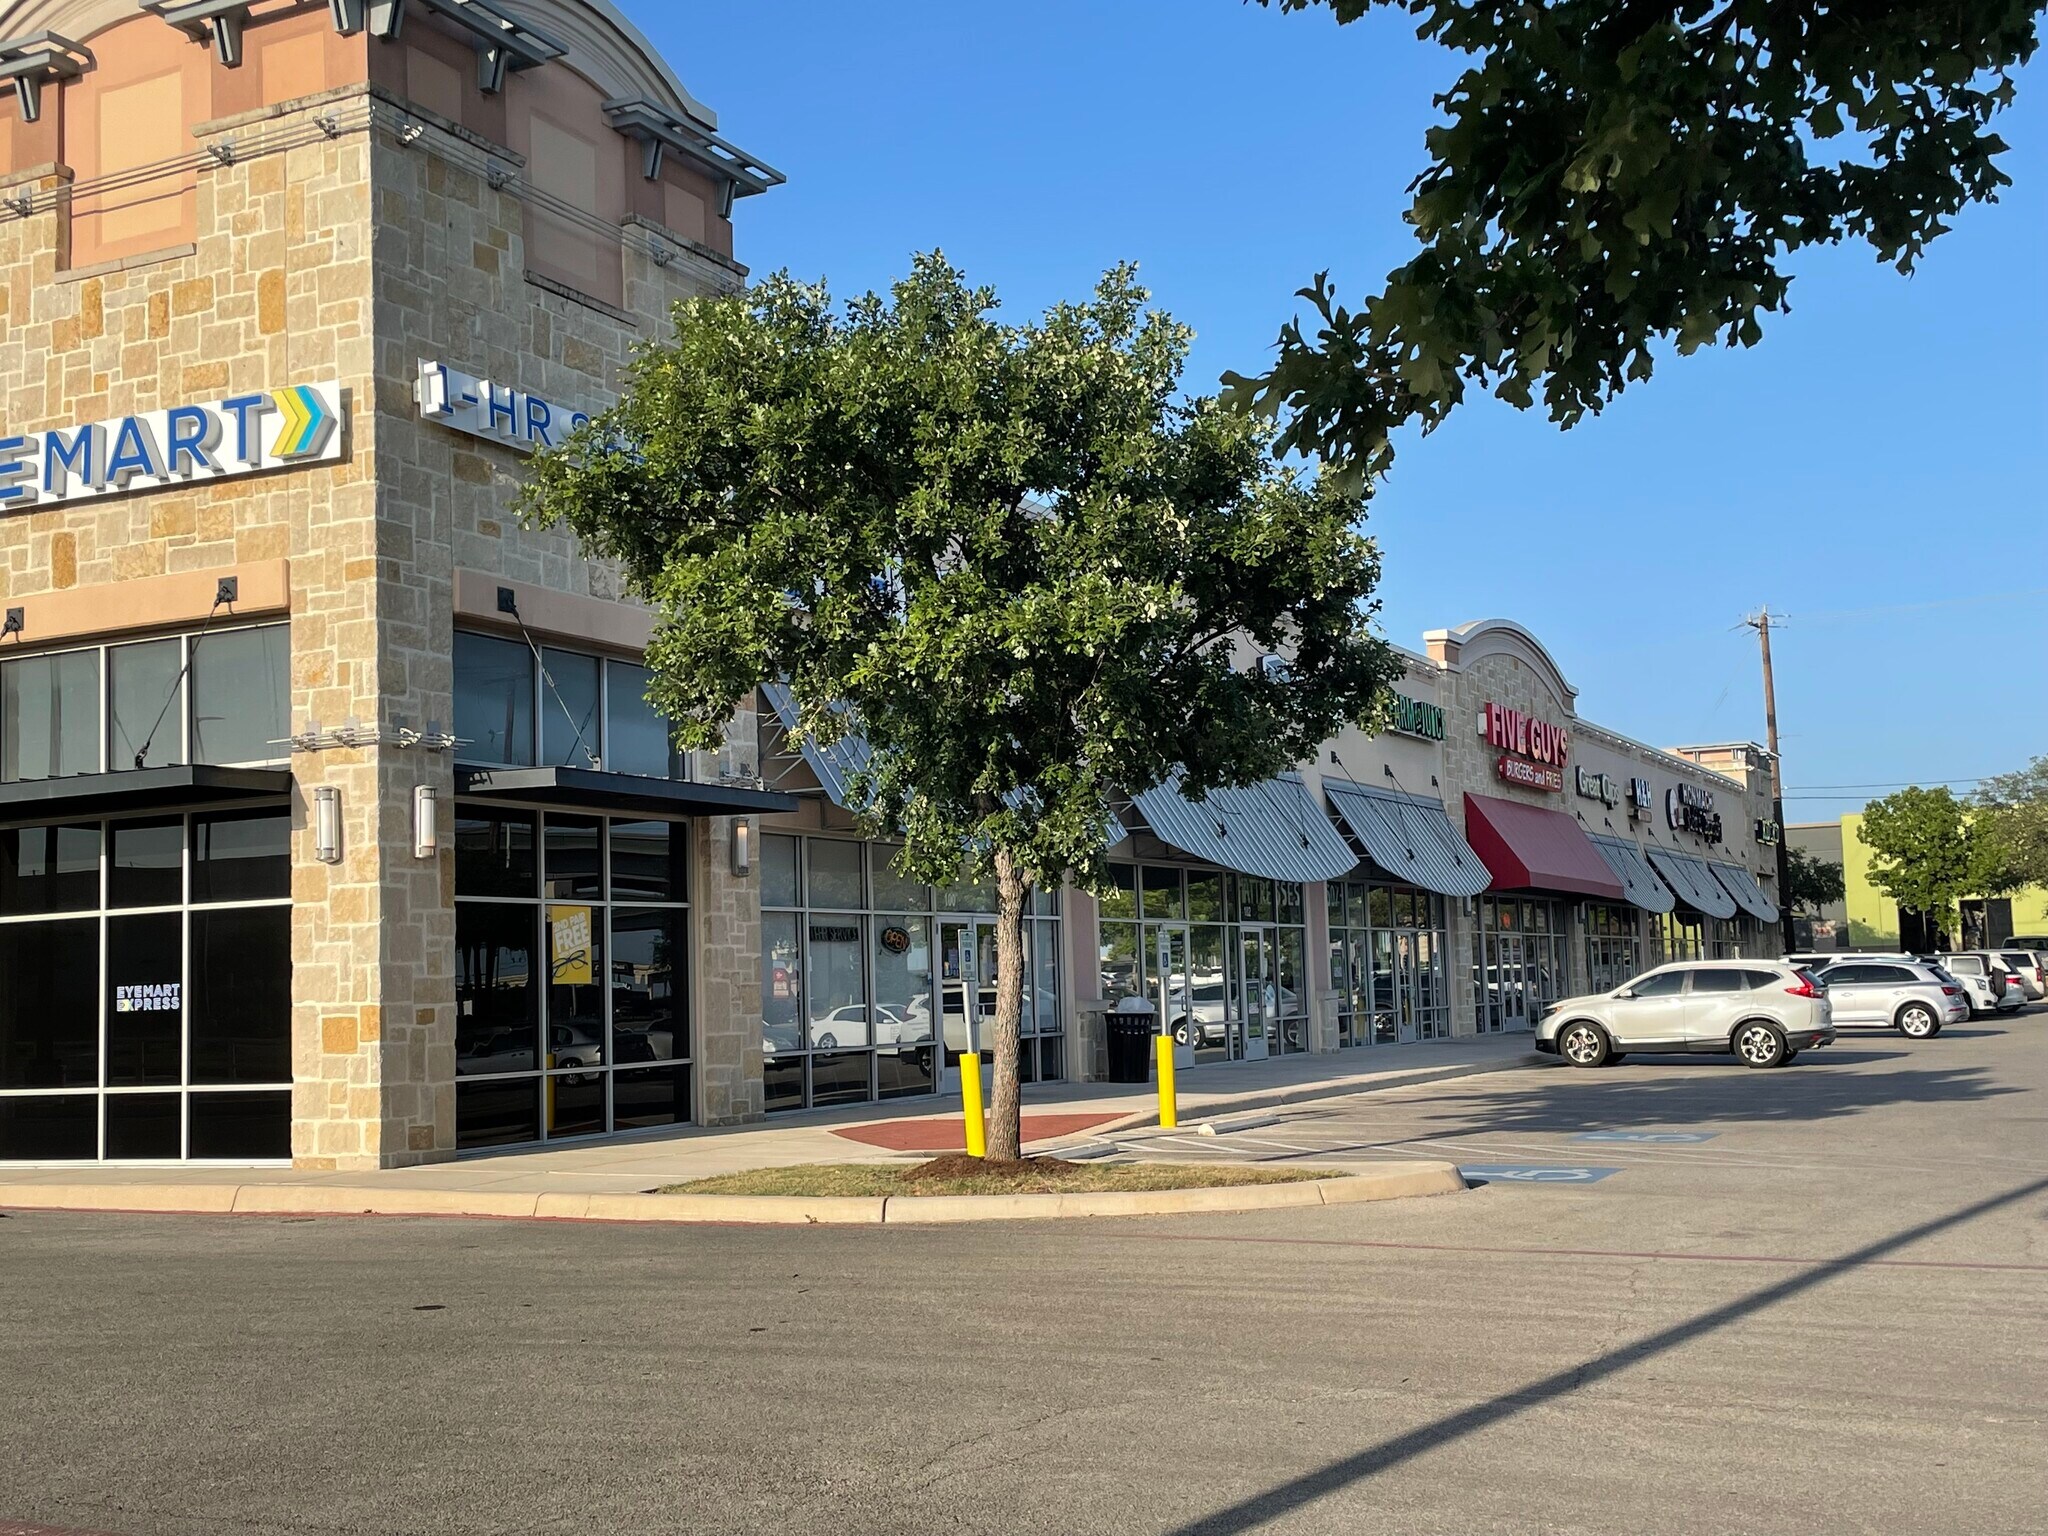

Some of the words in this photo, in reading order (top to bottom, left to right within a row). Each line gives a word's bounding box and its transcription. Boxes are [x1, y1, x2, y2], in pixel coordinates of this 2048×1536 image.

[425, 362, 552, 447] 1-HR
[1490, 703, 1527, 755] FIVE
[1530, 717, 1569, 768] GUYS
[1506, 759, 1534, 782] BURGERS
[1535, 769, 1545, 785] and
[1546, 770, 1562, 789] FRIES
[1579, 767, 1602, 800] Great
[553, 919, 569, 932] 2ND
[570, 912, 586, 926] PAIR
[555, 922, 590, 953] FREE
[885, 928, 908, 949] OPEN
[116, 983, 180, 999] EYEMART
[116, 996, 180, 1012] EXPRESS
